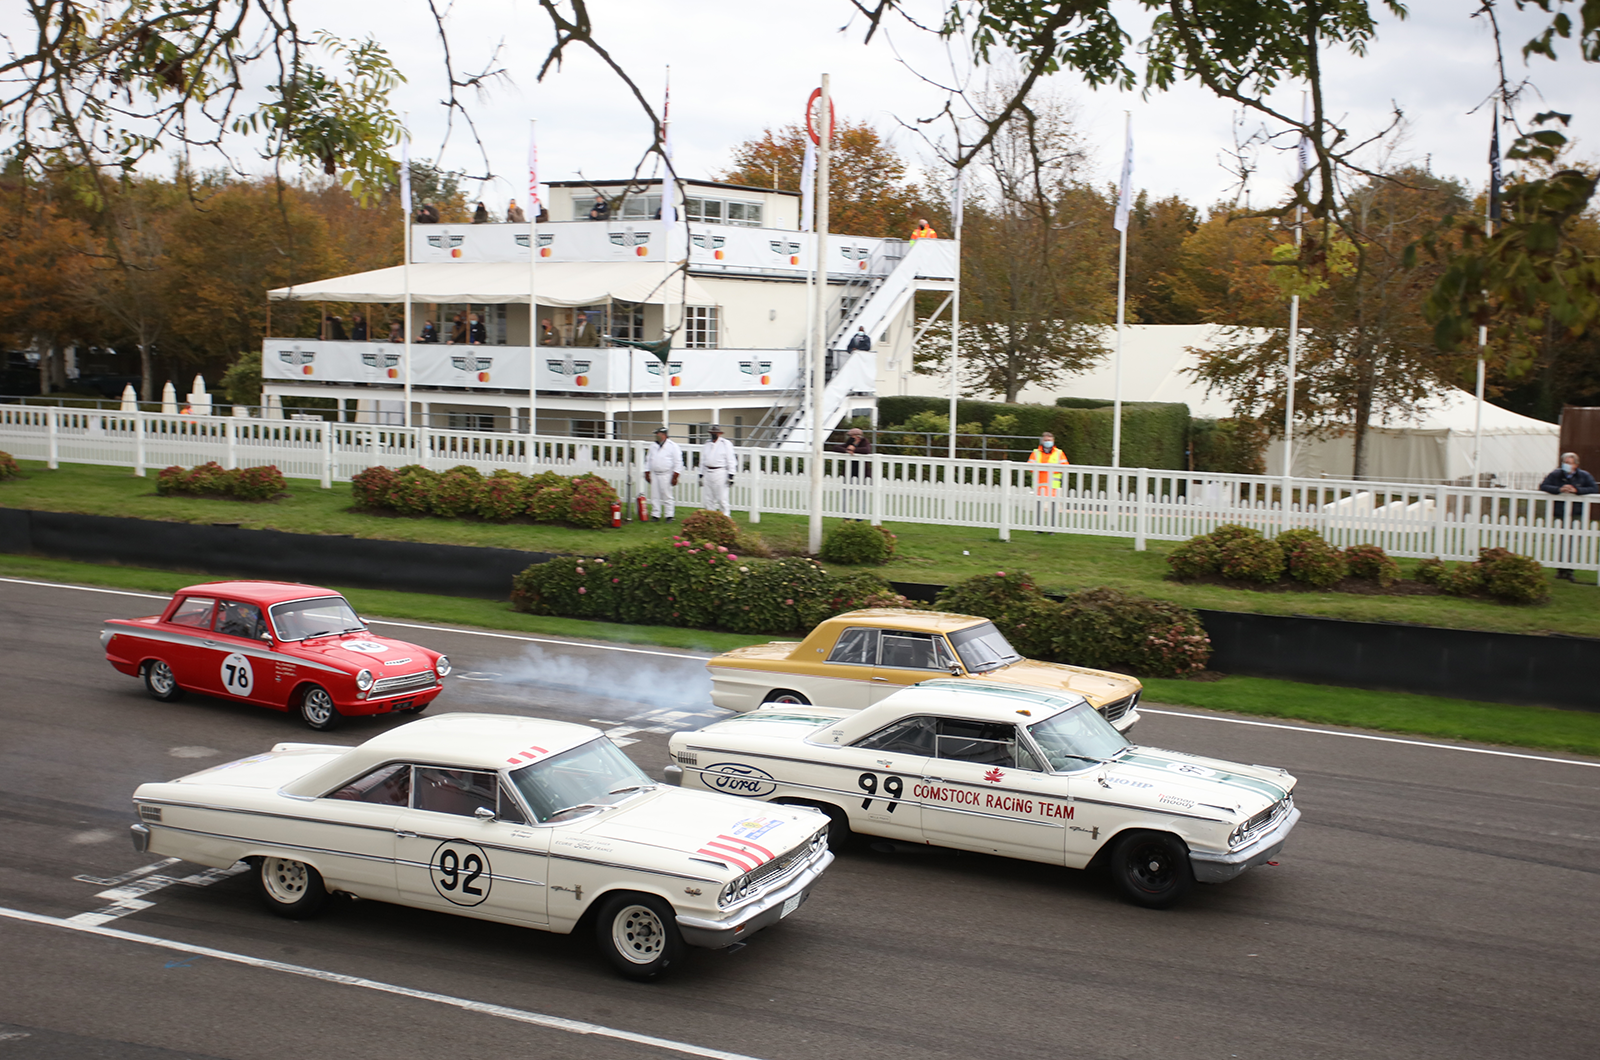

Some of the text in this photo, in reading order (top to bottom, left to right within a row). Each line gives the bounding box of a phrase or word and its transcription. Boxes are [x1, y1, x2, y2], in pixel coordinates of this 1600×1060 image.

[225, 663, 249, 688] 78
[716, 766, 763, 793] Ford
[858, 772, 904, 813] 99
[1130, 781, 1154, 789] HP
[913, 784, 1075, 820] COMSTOCK RACING TEAM
[1159, 797, 1195, 809] moody
[440, 848, 483, 896] 92
